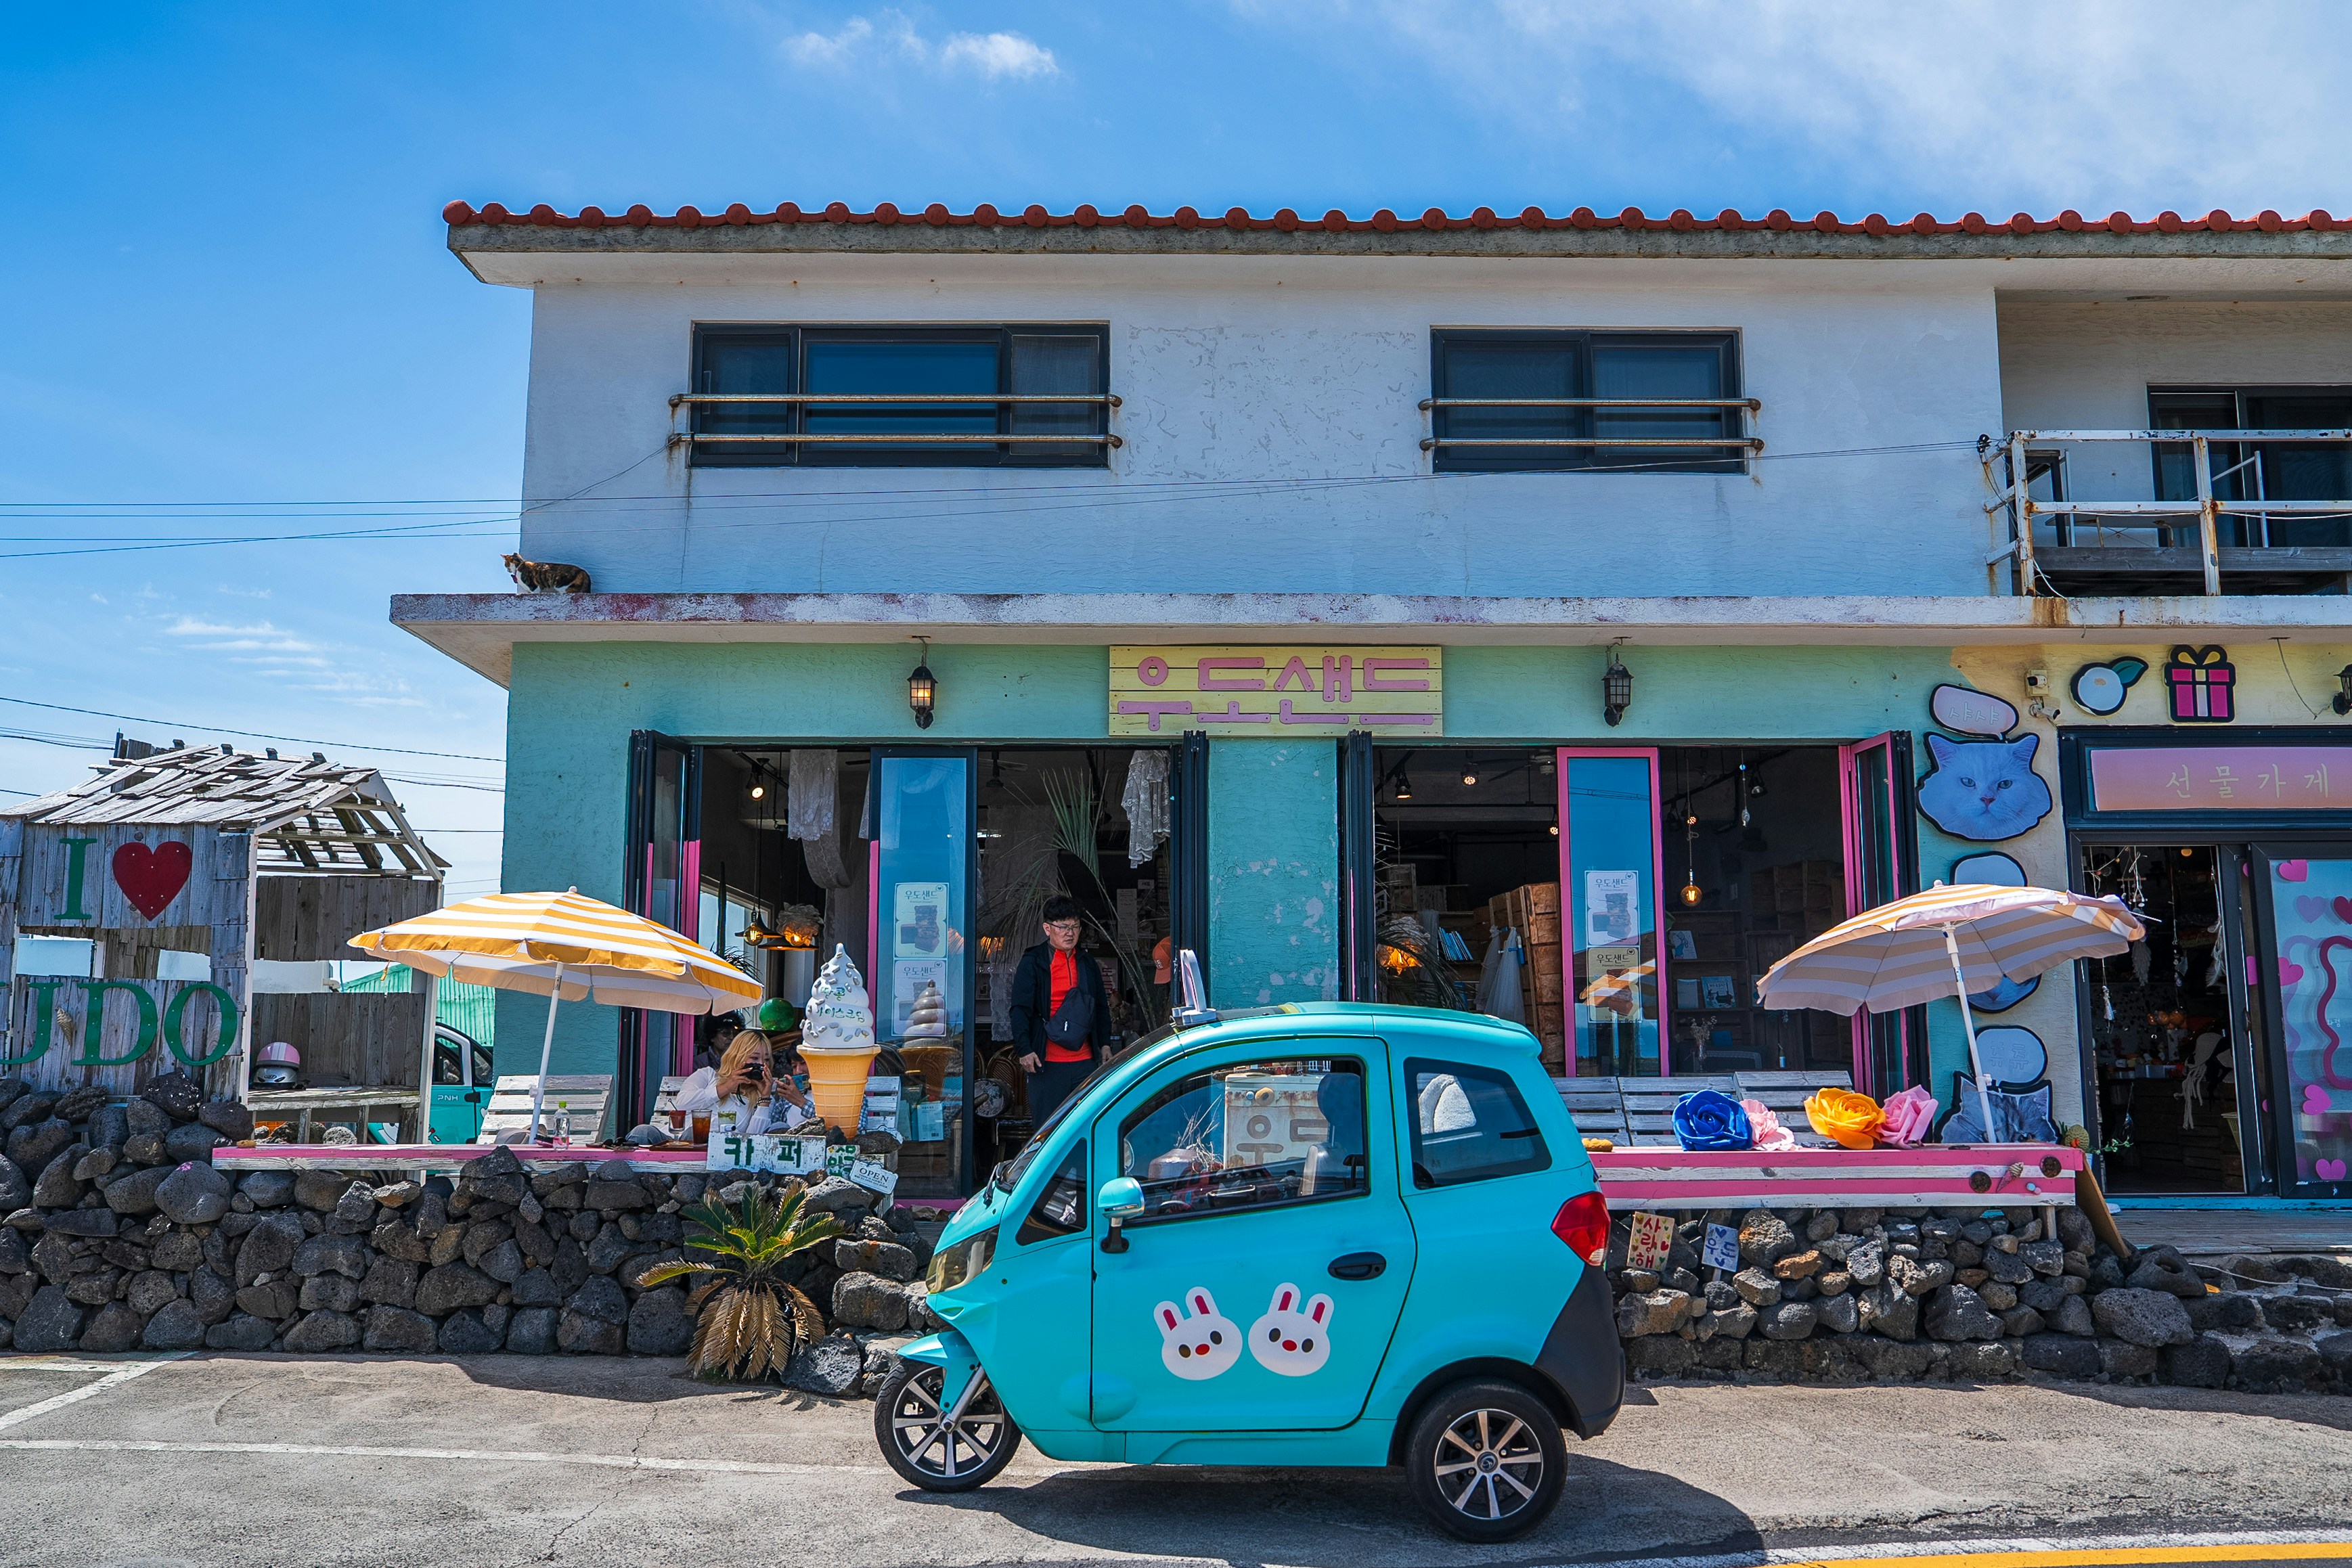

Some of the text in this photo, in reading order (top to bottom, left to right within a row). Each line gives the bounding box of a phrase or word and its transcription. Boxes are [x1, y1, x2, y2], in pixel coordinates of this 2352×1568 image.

[1117, 655, 1434, 732] 우도샌드
[1949, 702, 1999, 725] 샤샤
[2165, 763, 2330, 799] 선물가게
[53, 838, 97, 920] I
[1595, 878, 1628, 888] 우도샌드
[904, 890, 938, 900] 우도샌드
[1596, 954, 1630, 964] 우도샌드
[903, 966, 937, 977] 우도샌드
[860, 1167, 889, 1182] OPEN
[1635, 1217, 1661, 1269] 사랑해
[1705, 1237, 1736, 1258] 우도
